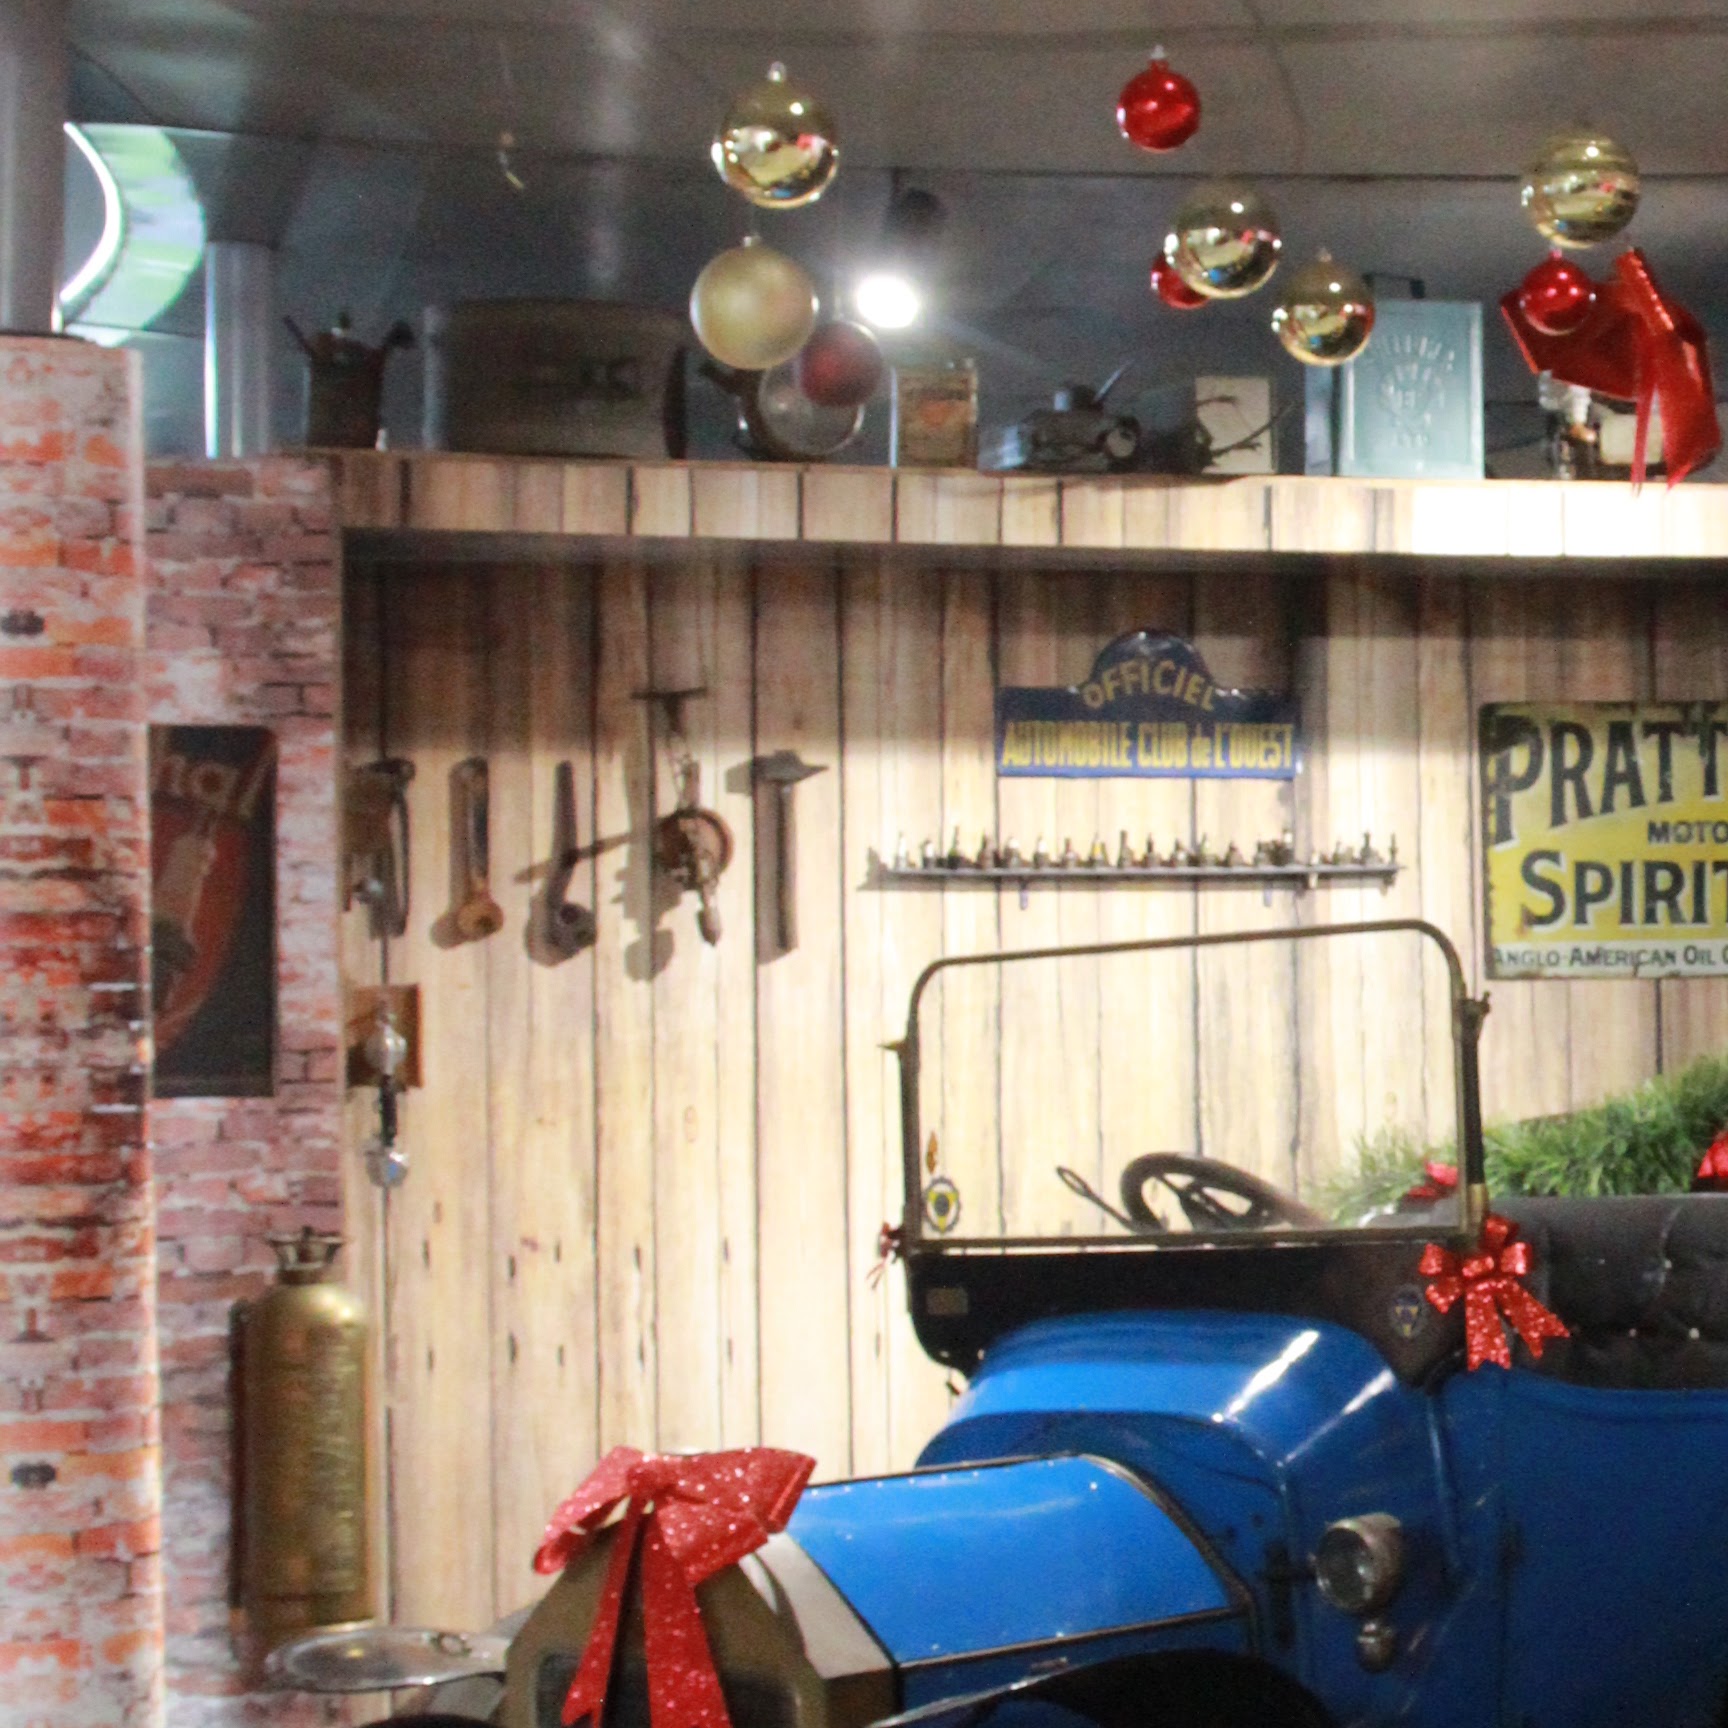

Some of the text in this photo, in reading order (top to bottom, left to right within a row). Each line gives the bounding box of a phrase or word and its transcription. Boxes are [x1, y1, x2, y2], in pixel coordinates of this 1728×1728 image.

[1083, 659, 1215, 712] OFFICIEL
[1002, 722, 1132, 768] AUTOMOBILE
[1137, 722, 1188, 768] CLUB
